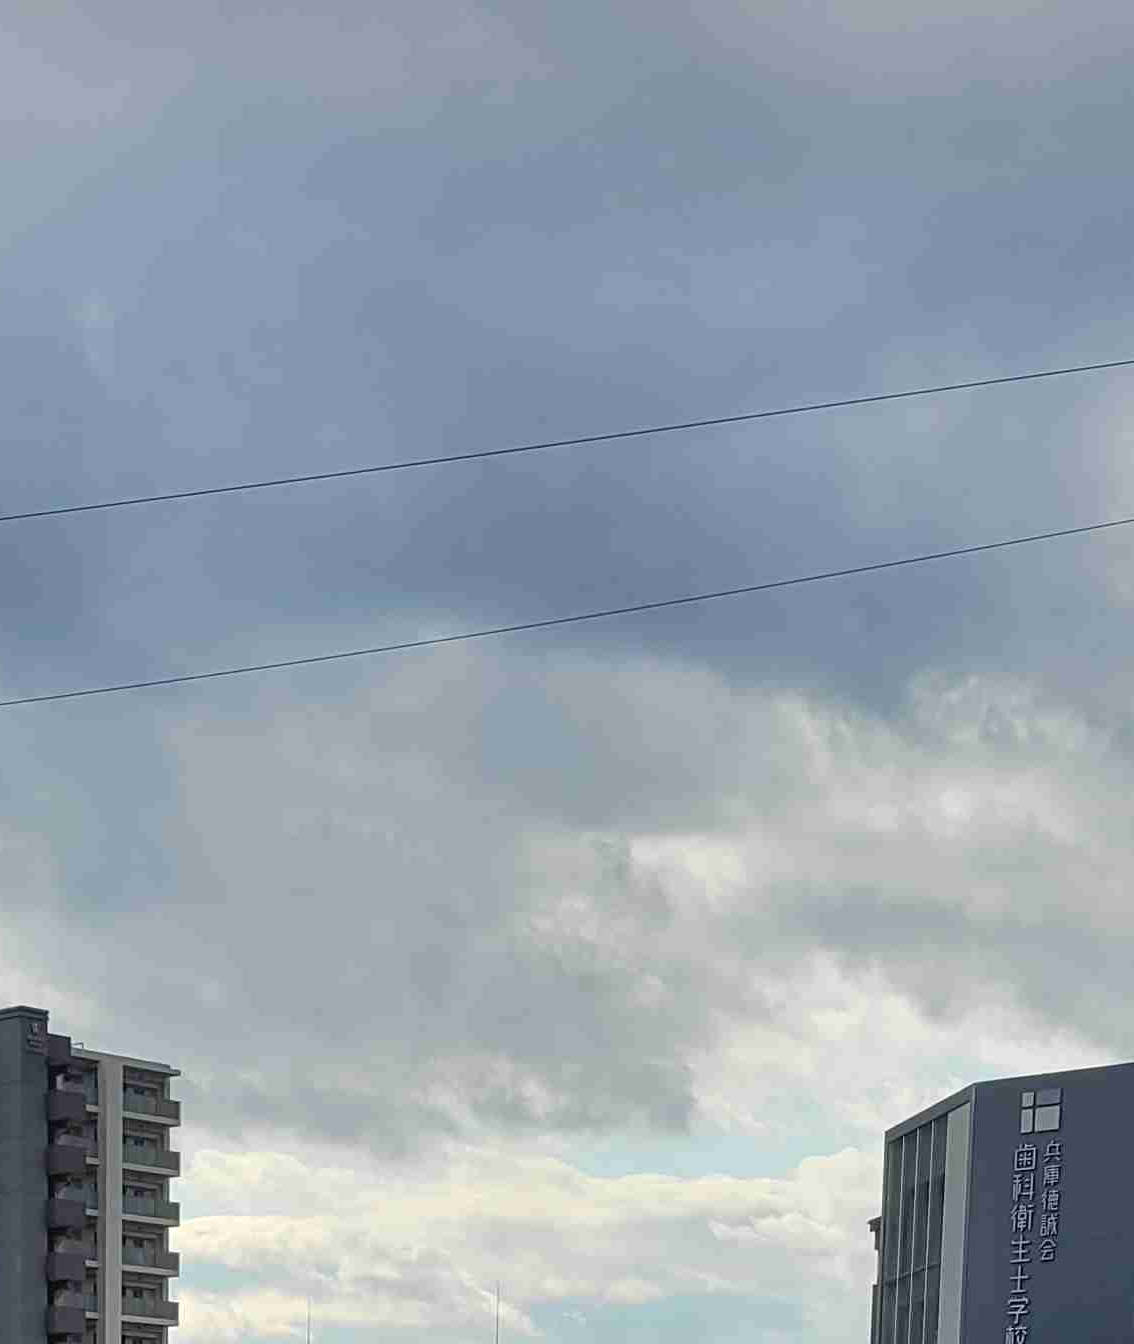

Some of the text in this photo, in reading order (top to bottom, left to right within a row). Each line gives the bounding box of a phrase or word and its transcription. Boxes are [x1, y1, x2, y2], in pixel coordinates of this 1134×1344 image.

[1040, 1140, 1062, 1261] 兵庫徳誠会
